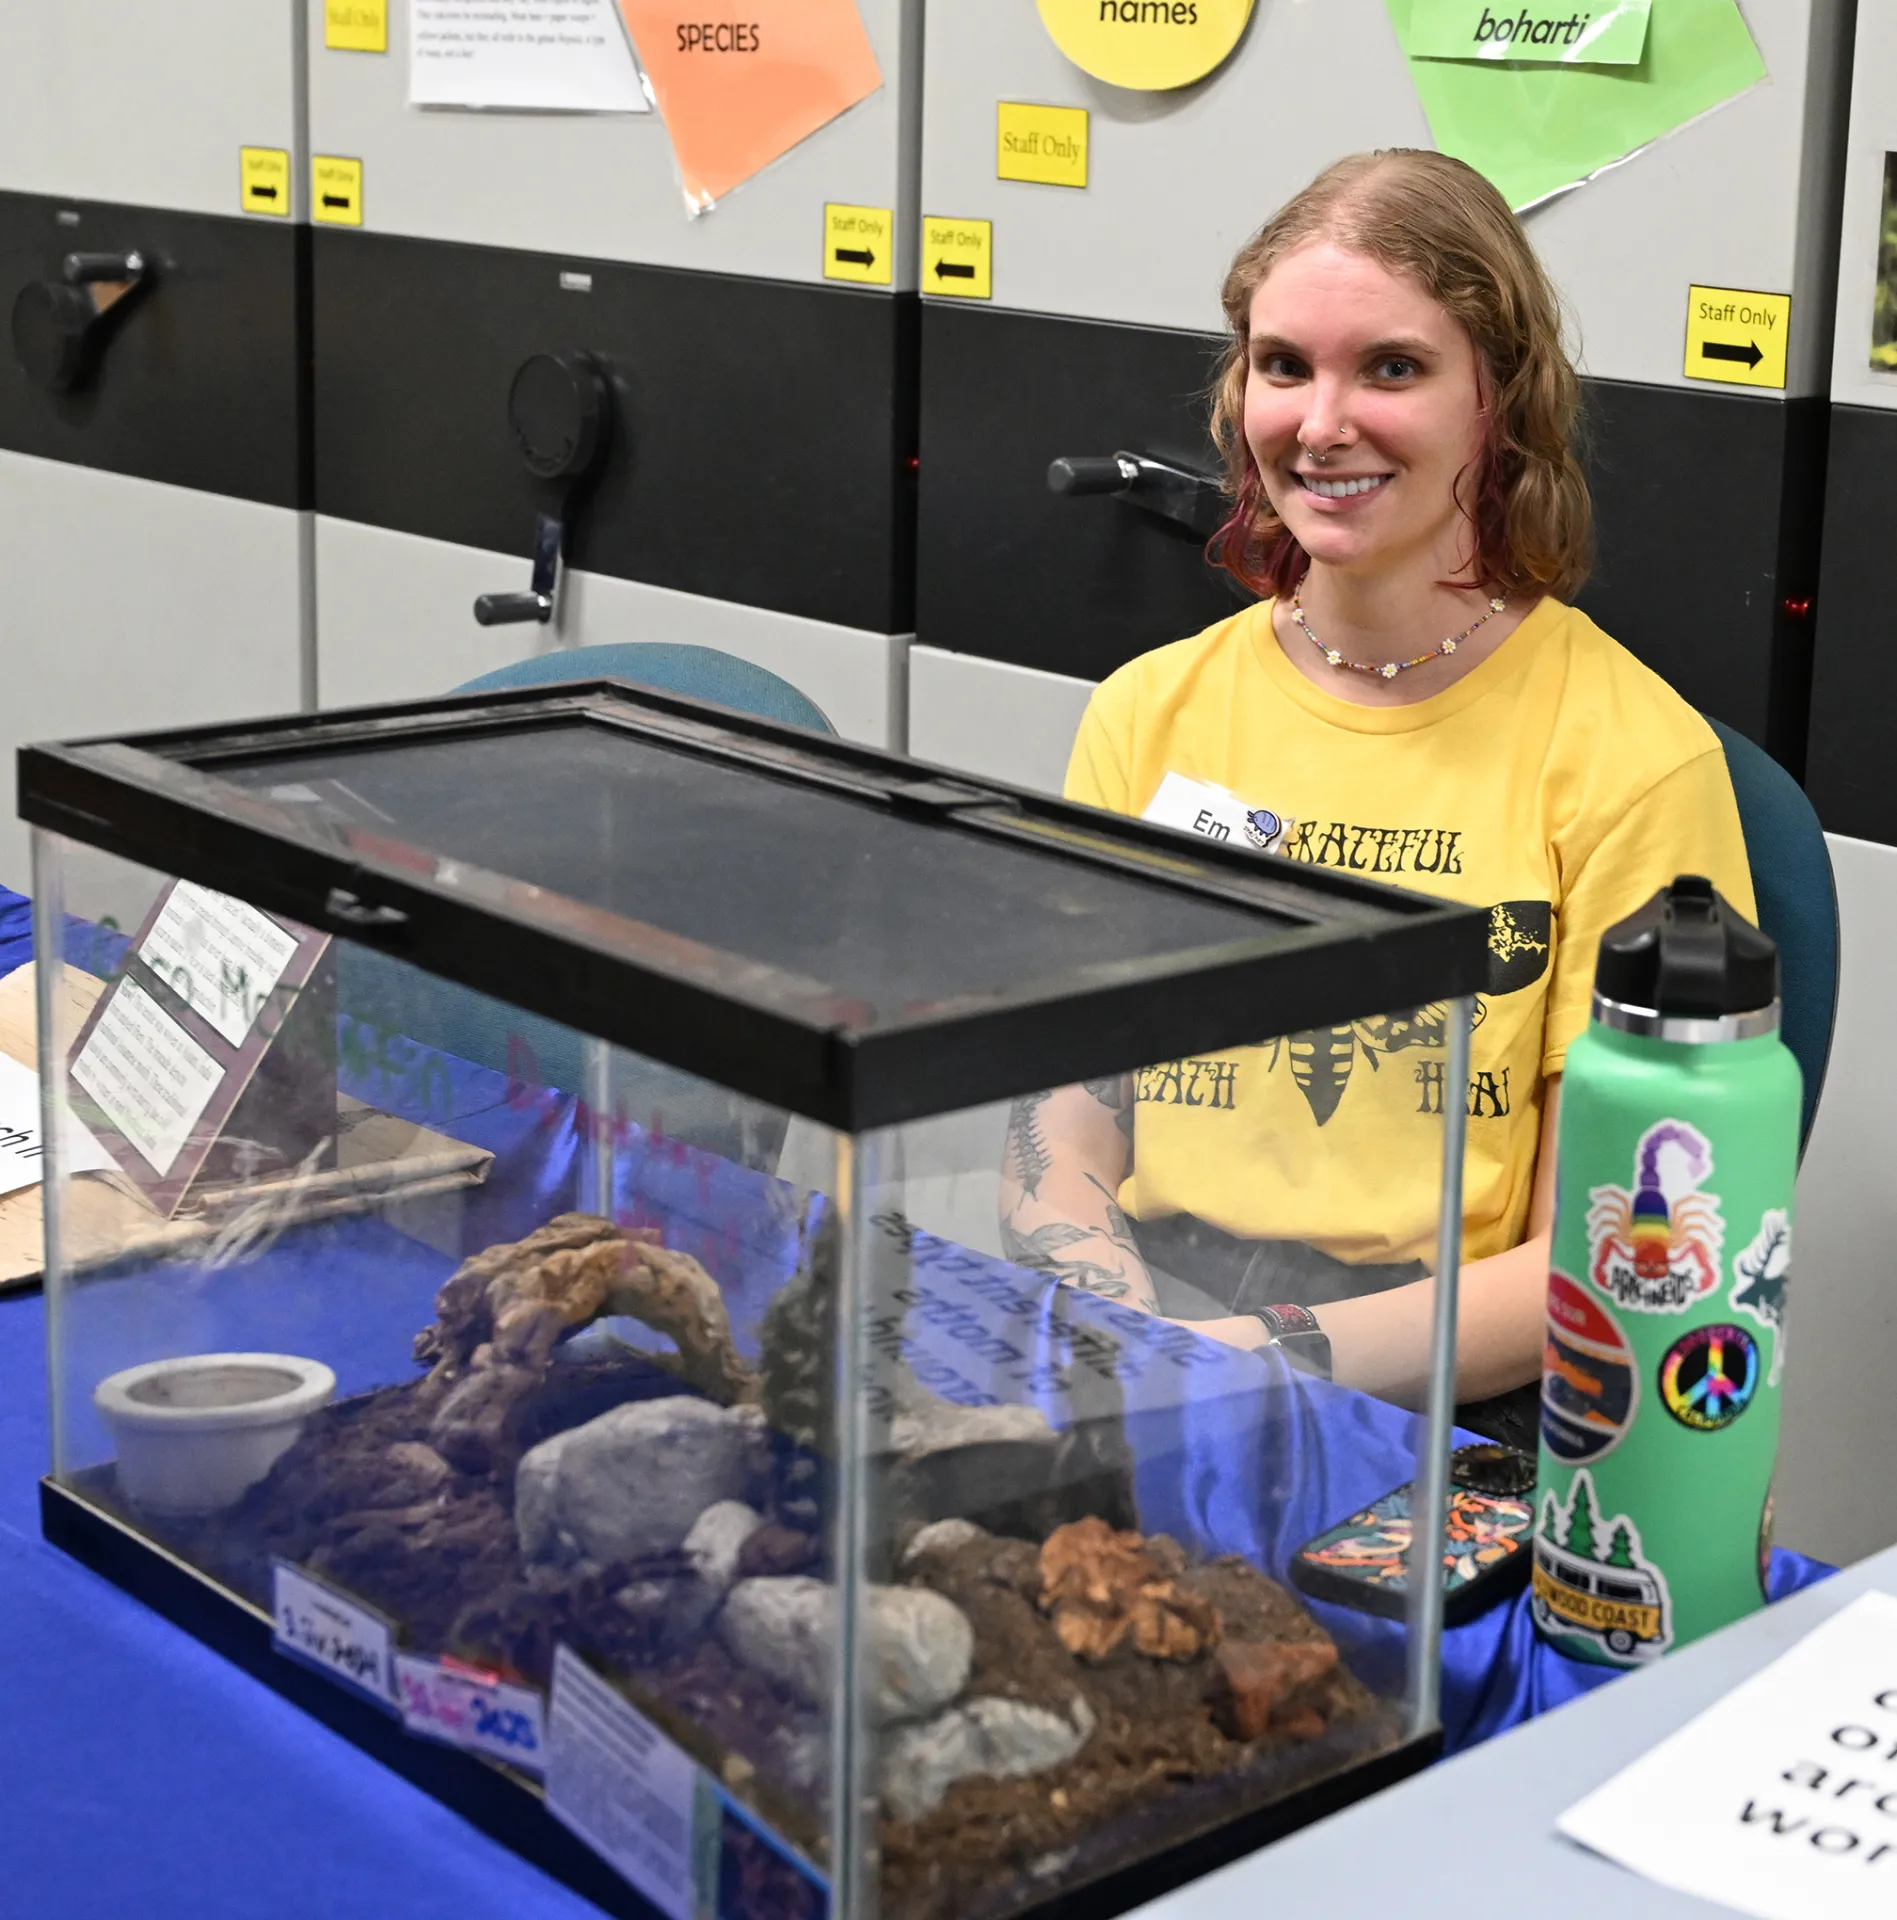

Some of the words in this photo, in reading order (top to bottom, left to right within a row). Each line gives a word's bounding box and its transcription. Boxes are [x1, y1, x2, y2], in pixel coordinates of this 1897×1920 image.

[1099, 0, 1197, 25] names
[1473, 7, 1590, 45] boharti
[676, 24, 760, 53] SPECIES
[1003, 131, 1039, 156] Staff
[1042, 134, 1081, 165] Only
[832, 217, 855, 231] Staff
[858, 220, 883, 237] Only
[930, 230, 954, 244] Staff
[957, 232, 982, 250] Only
[1699, 302, 1736, 321] Staff
[1739, 307, 1777, 330] Only
[1192, 808, 1231, 841] Em
[1591, 1601, 1649, 1629] COAST
[1831, 1724, 1897, 1762] o
